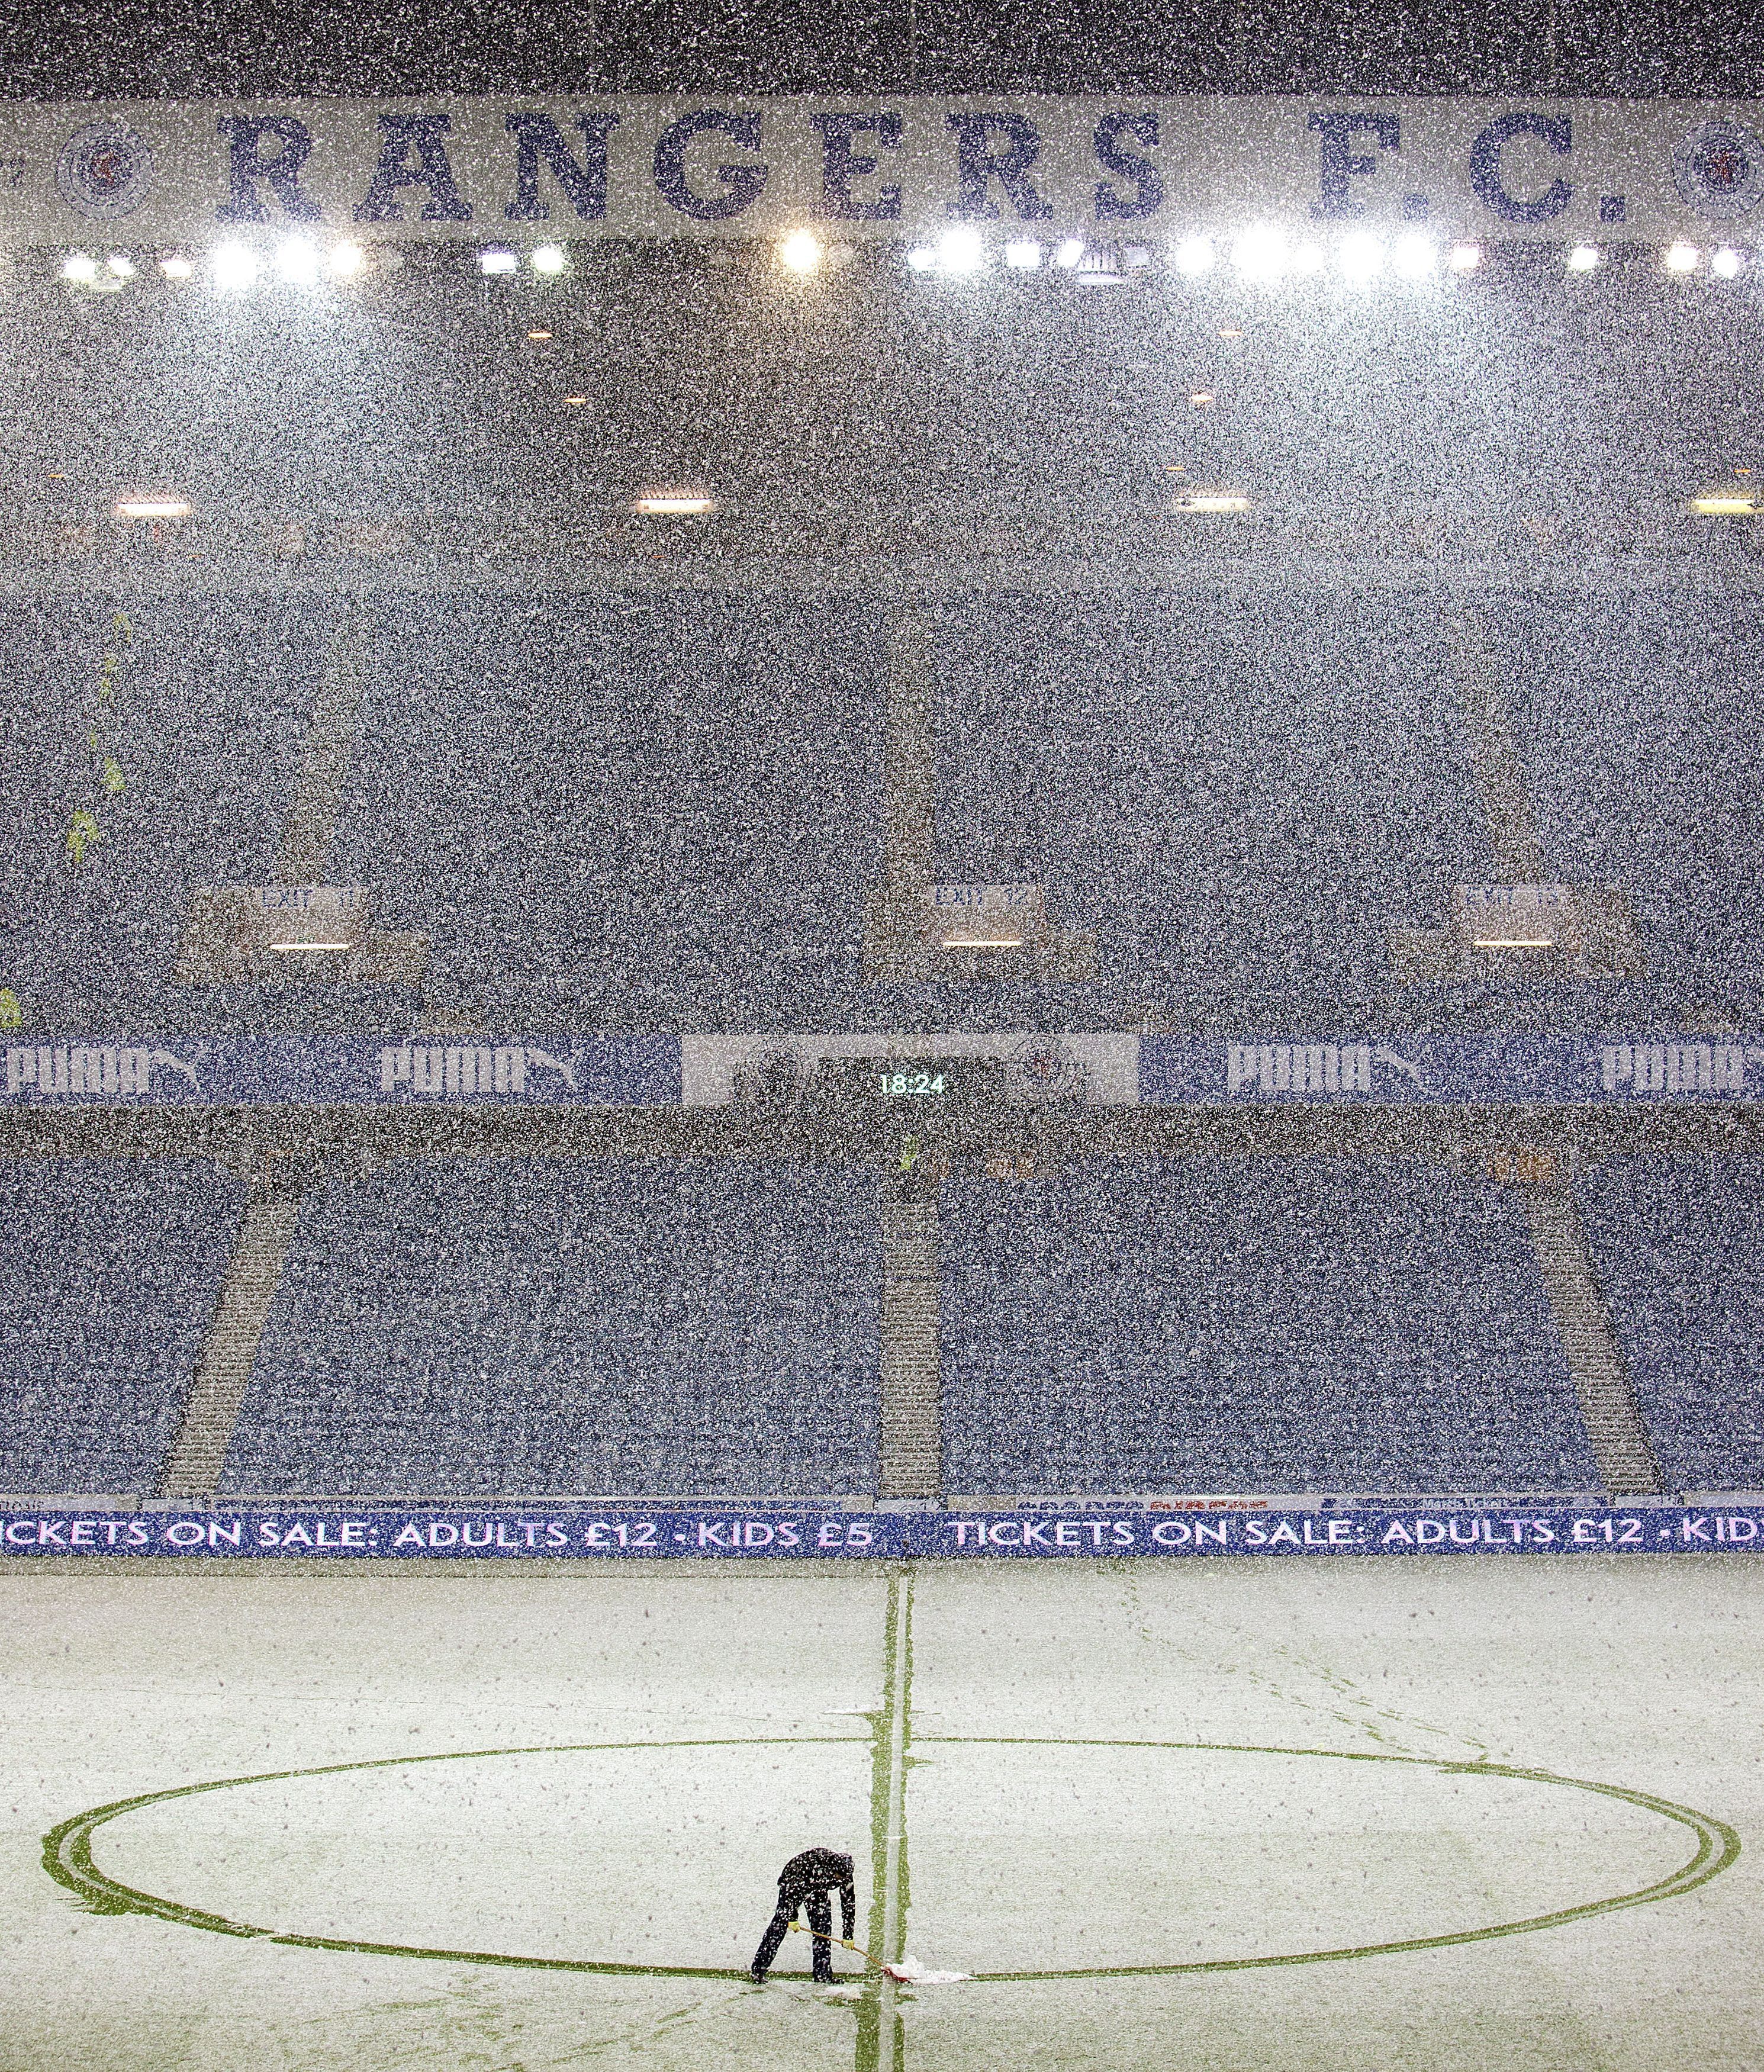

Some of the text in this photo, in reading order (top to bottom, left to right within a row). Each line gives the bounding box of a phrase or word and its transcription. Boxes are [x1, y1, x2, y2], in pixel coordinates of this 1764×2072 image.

[216, 108, 1164, 221] RANGERS
[1308, 111, 1626, 224] F.C.
[262, 889, 313, 908] EXIT
[935, 886, 1029, 906] EXIT 12
[6, 1047, 151, 1093] PUMA
[379, 1047, 526, 1093] PUMA
[880, 1074, 946, 1095] 18:24
[1227, 1044, 1372, 1092] PUMA
[1601, 1044, 1745, 1092] PUMA
[165, 1521, 241, 1546] ON
[258, 1521, 378, 1547] SALE:
[393, 1521, 568, 1547] ADULTS
[585, 1521, 657, 1547] £12
[698, 1521, 799, 1546] KIDS
[817, 1522, 873, 1546] £5
[948, 1517, 1764, 1546] TICKETS ON SALE: ADULTS £12 KID
